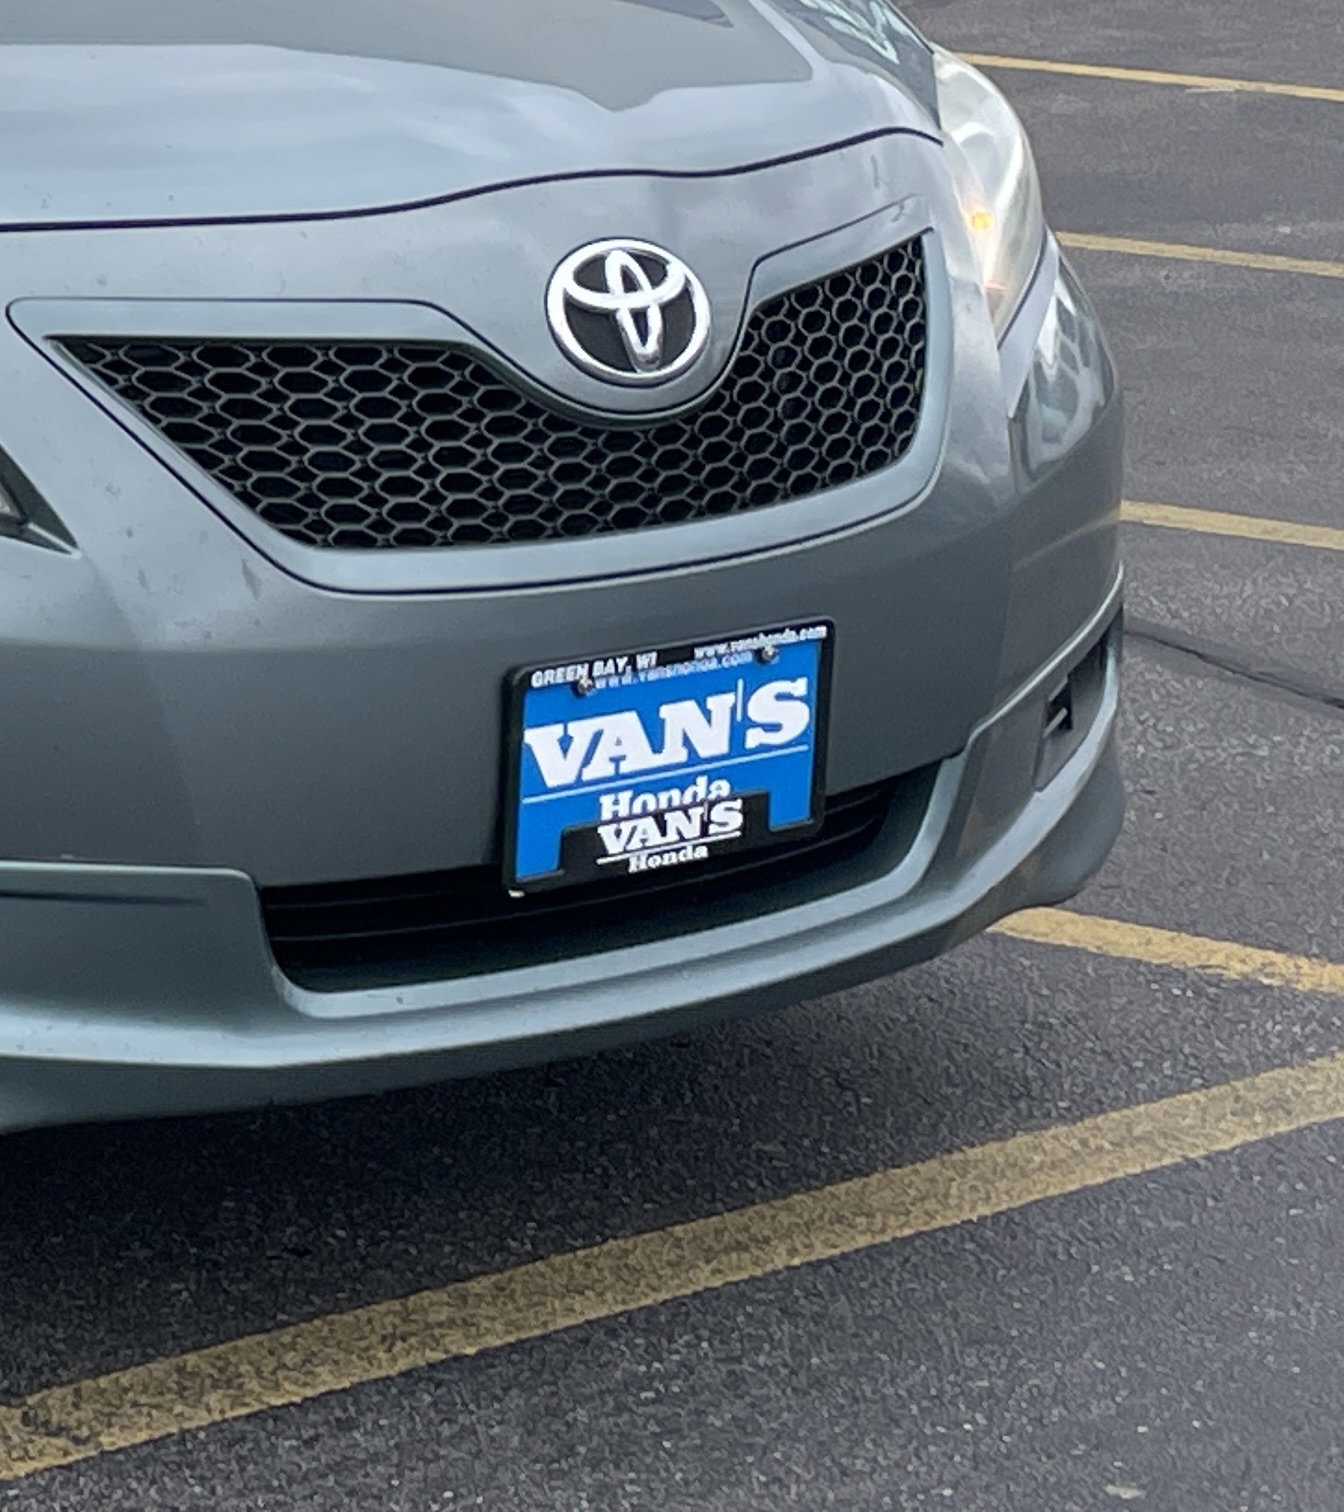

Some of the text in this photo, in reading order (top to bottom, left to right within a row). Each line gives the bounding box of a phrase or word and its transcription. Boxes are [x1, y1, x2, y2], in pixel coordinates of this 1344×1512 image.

[531, 662, 590, 688] GREEN
[636, 651, 658, 669] WI
[524, 677, 810, 787] VAN'S
[599, 775, 731, 821] Honda
[597, 798, 744, 855] VAN'S
[628, 844, 708, 874] Honda
